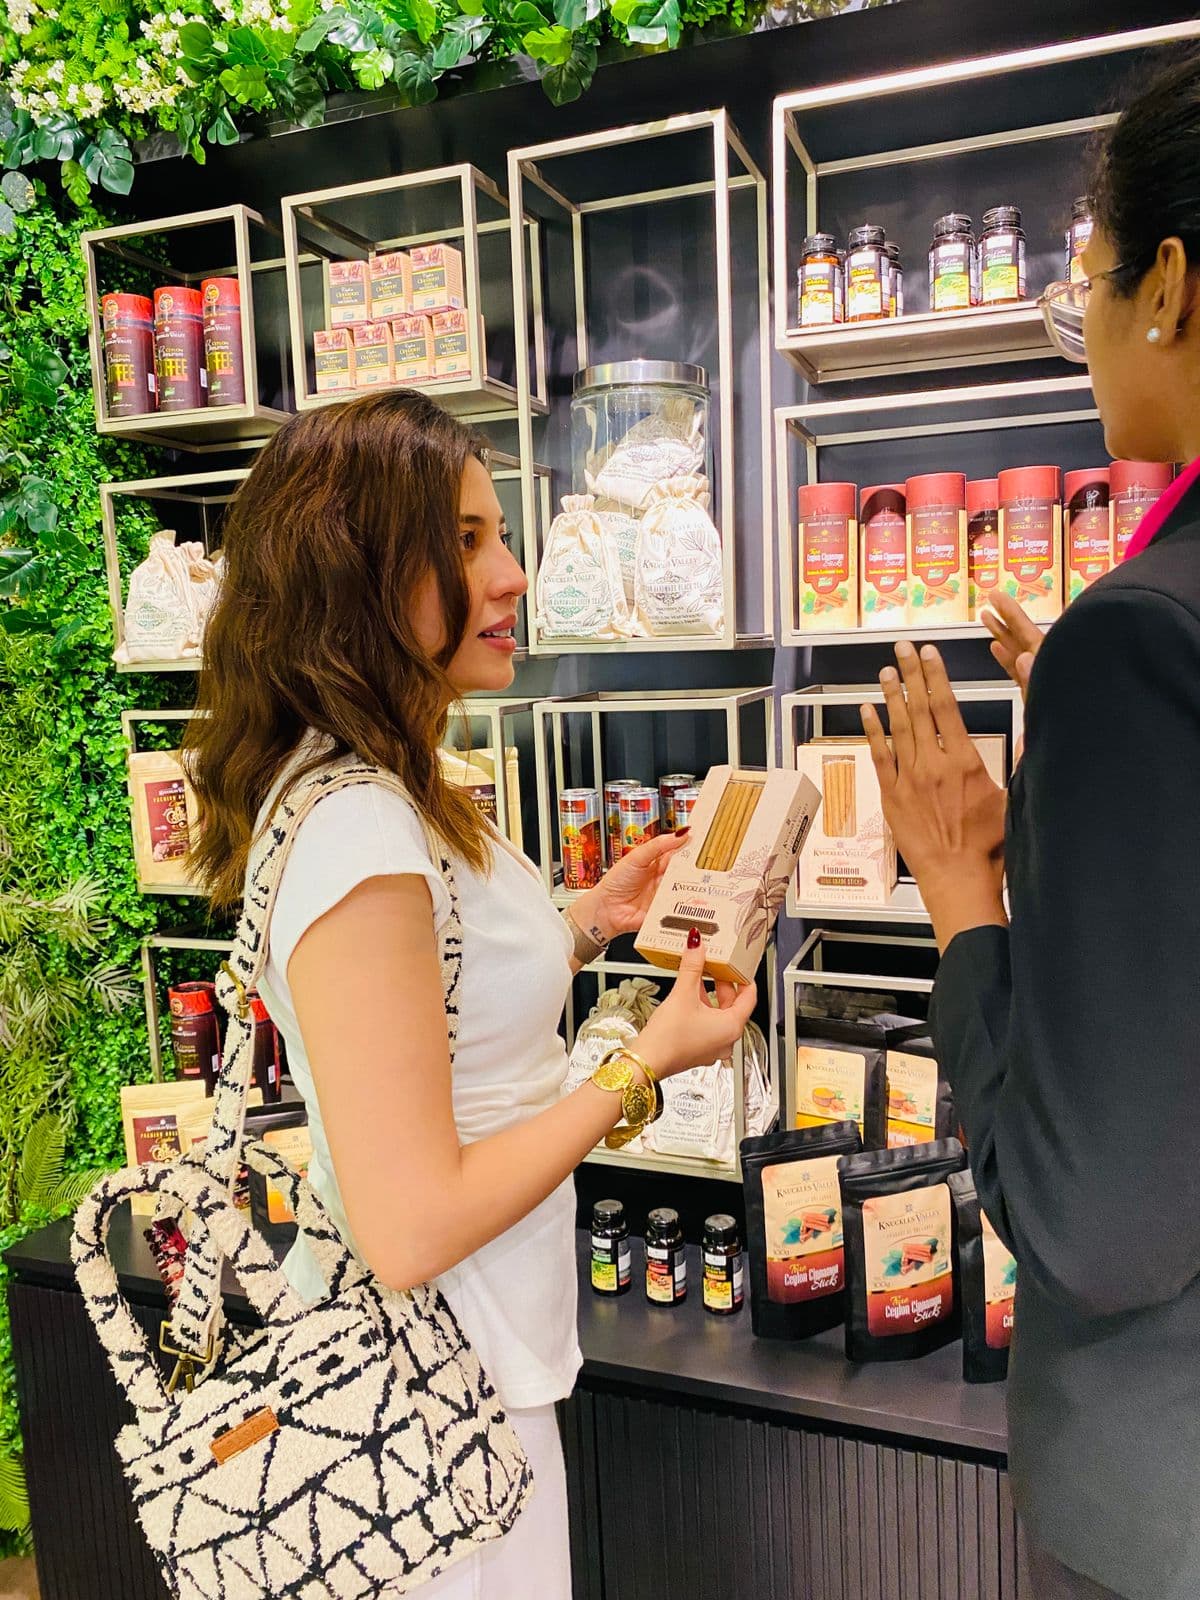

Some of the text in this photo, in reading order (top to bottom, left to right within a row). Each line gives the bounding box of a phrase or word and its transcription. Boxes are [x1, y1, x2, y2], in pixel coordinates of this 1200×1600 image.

[823, 864, 860, 875] Cinnamon
[672, 882, 736, 897] KNUCKLES VALLEY
[673, 902, 716, 920] Cinnamon
[776, 1186, 812, 1198] KNUCKLES
[878, 1217, 915, 1230] KNUCKLES
[784, 1264, 839, 1287] Ceylon Cinnamon
[811, 1274, 838, 1291] Sticks
[885, 1294, 942, 1319] Ceylon Cinnamon
[914, 1305, 942, 1324] Sticks
